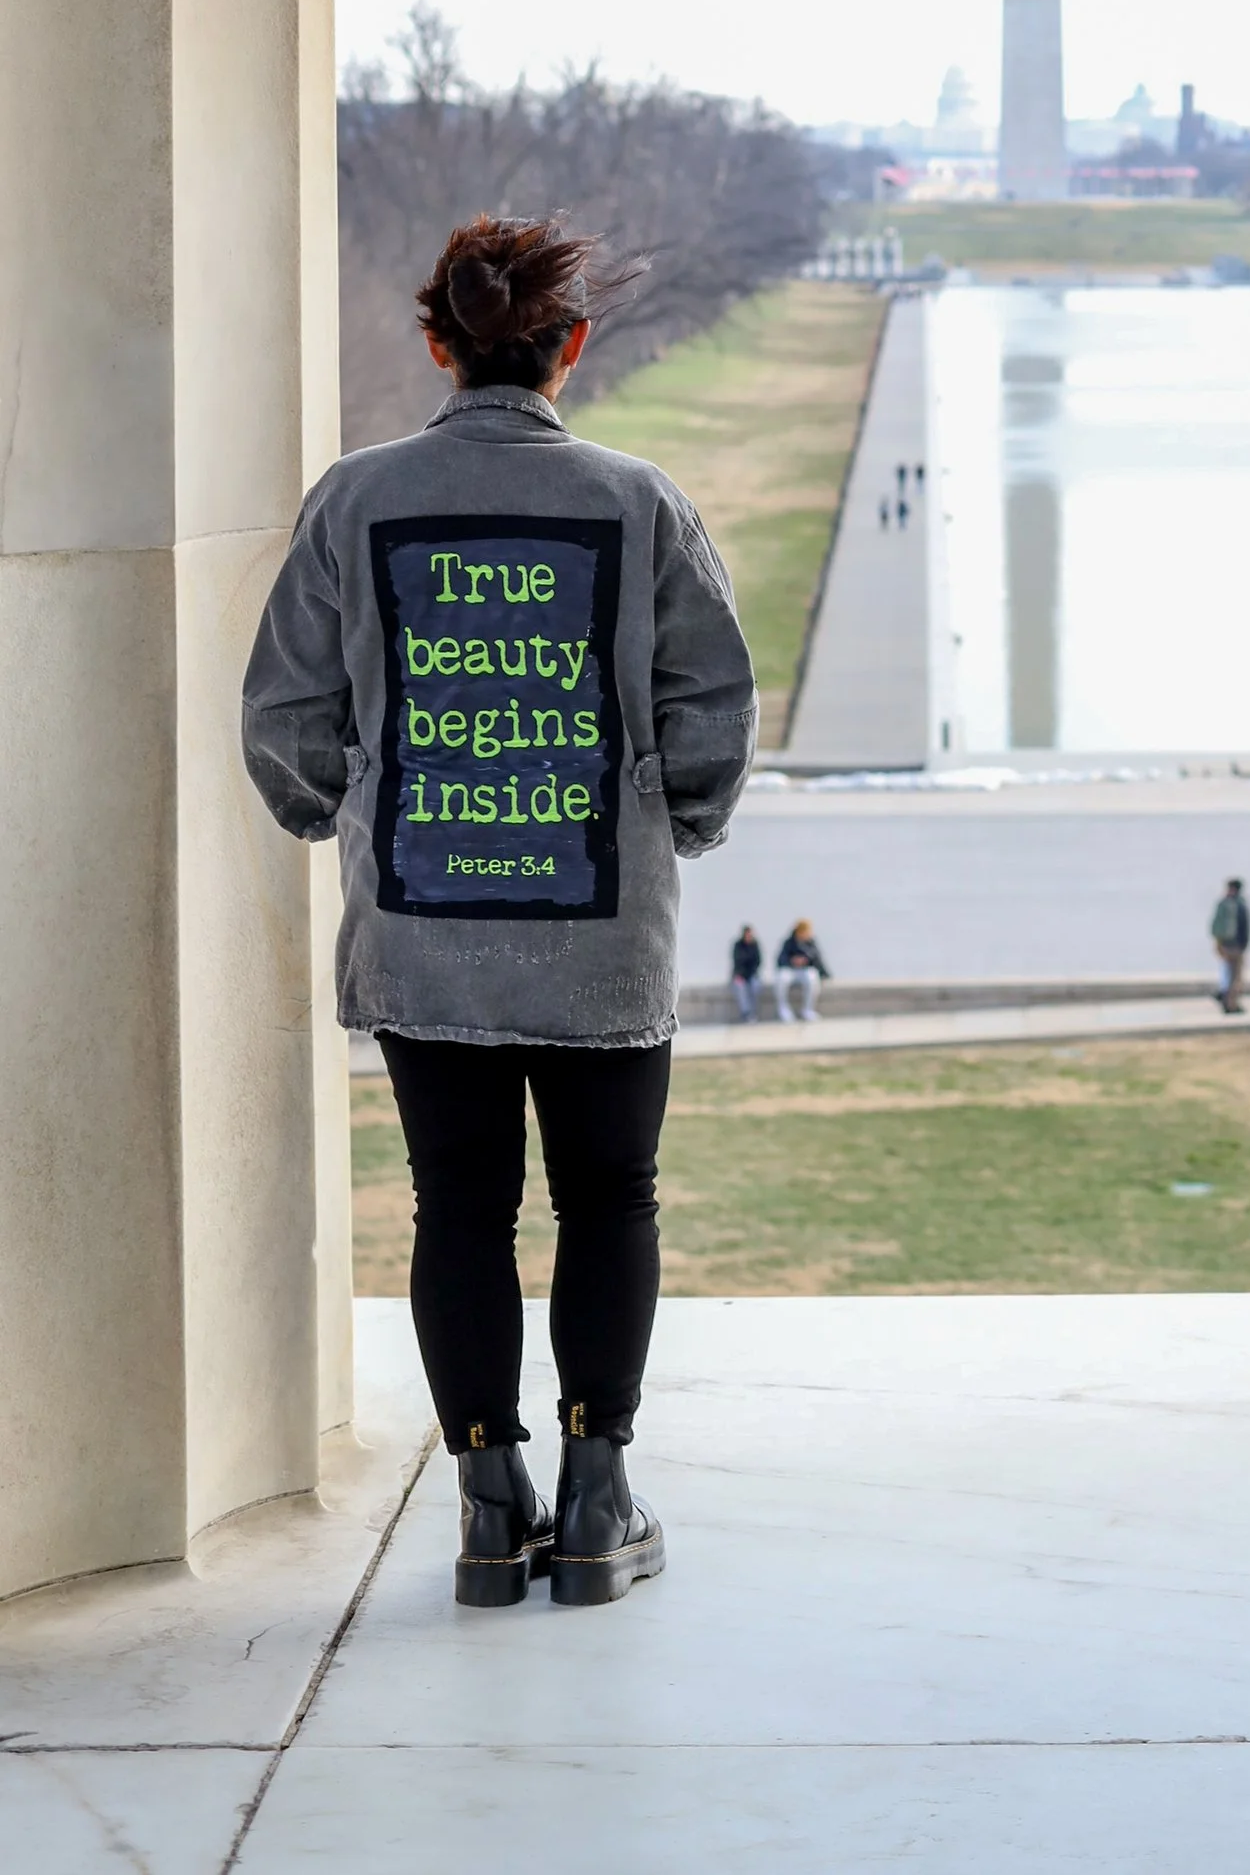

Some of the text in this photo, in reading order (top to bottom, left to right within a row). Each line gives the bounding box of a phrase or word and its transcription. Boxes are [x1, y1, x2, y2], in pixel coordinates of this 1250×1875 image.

[430, 552, 556, 604] True
[404, 626, 588, 691] beauty
[406, 698, 600, 760] begins
[406, 773, 599, 825] inside.
[446, 854, 556, 876] Peter 3:4
